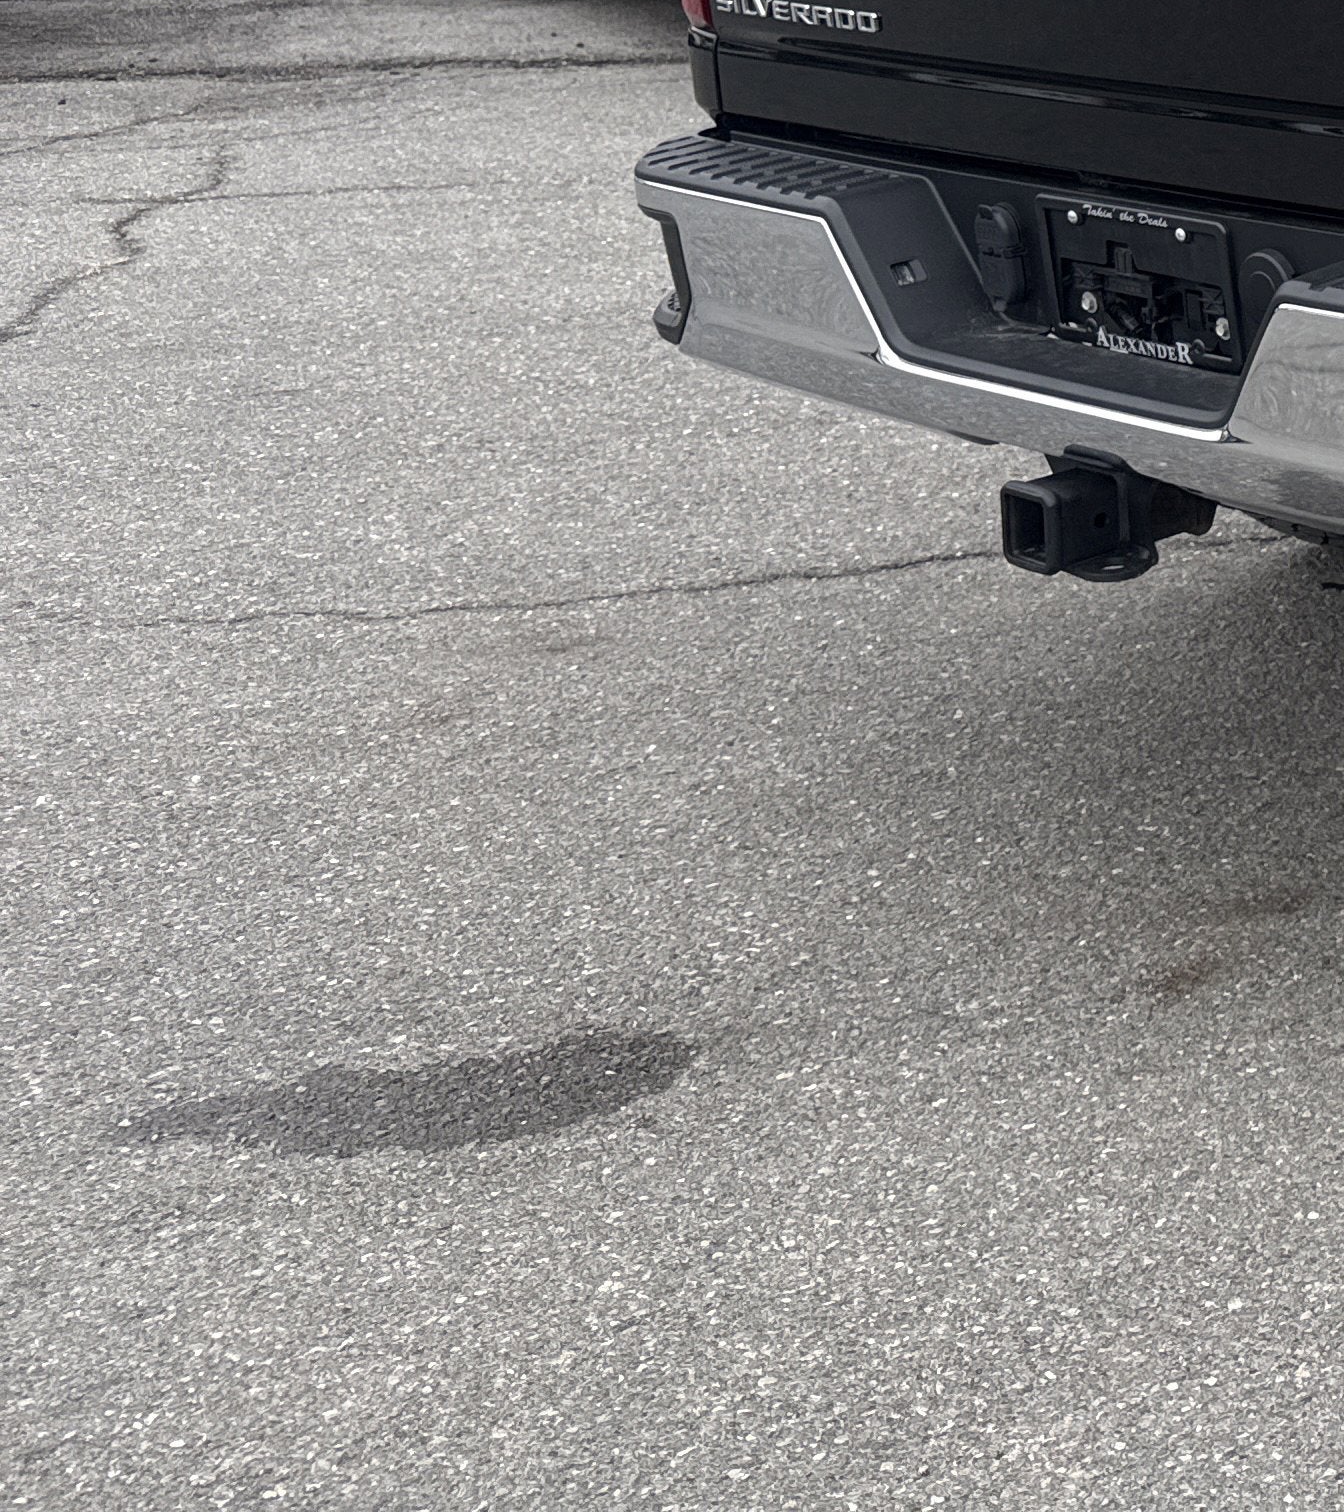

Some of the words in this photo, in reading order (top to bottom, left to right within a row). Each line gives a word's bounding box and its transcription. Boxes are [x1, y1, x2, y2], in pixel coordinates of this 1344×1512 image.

[1082, 202, 1116, 219] Takin'
[1119, 211, 1135, 223] the
[1137, 212, 1168, 228] Deals
[1096, 325, 1193, 365] ALEXANDER
